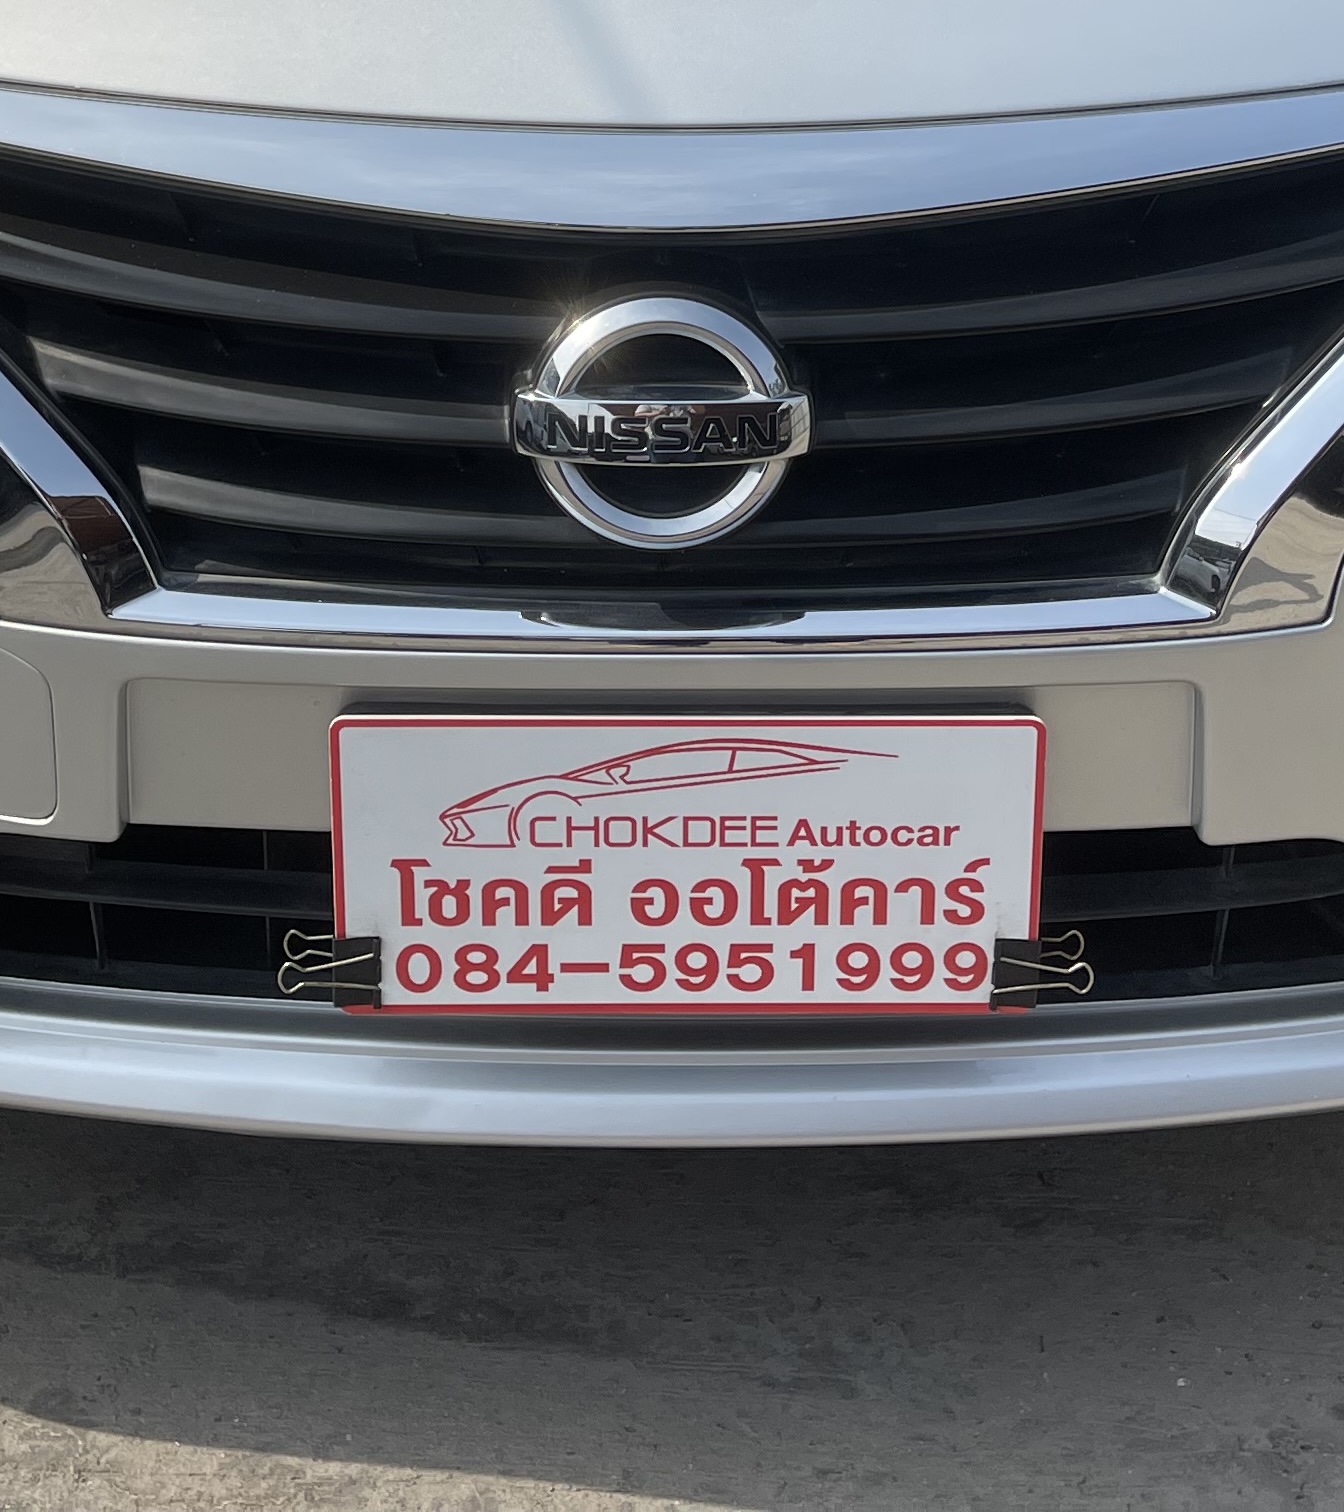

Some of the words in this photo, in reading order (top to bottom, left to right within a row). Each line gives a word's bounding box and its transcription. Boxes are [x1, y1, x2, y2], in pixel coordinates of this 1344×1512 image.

[545, 411, 780, 454] NISSAN
[528, 814, 780, 849] CHOKDEE
[786, 819, 961, 849] Autocar
[390, 857, 595, 928] โชคดี
[629, 857, 992, 928] ออโต้คาร์
[395, 942, 990, 995] 084-5951999
